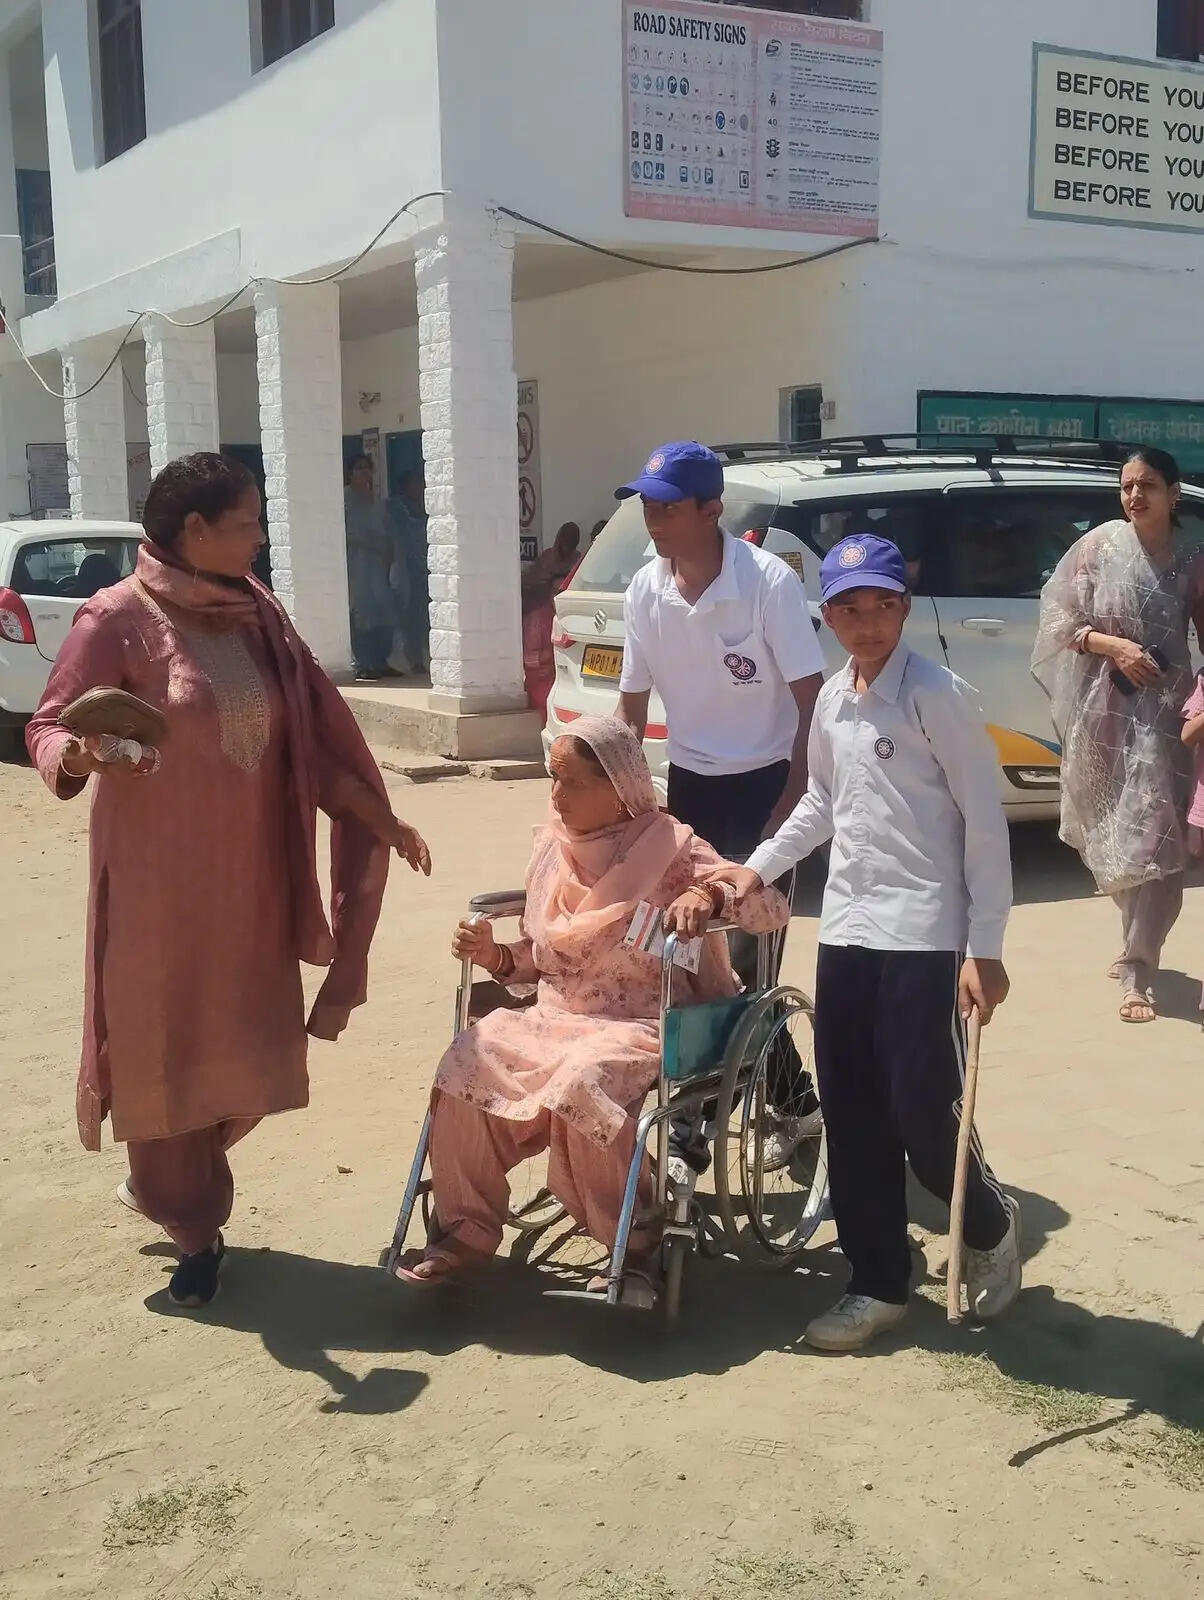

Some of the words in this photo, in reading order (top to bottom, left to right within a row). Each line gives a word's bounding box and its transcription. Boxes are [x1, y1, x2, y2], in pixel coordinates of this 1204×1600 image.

[634, 12, 666, 34] ROAD
[669, 16, 712, 40] SAFETY
[714, 22, 746, 45] SIGNS
[1056, 71, 1150, 103] BEFORE
[1055, 107, 1150, 138] BEFORE
[1163, 120, 1204, 144] YOU
[1054, 143, 1150, 173] BEFORE
[1053, 179, 1151, 209] BEFORE
